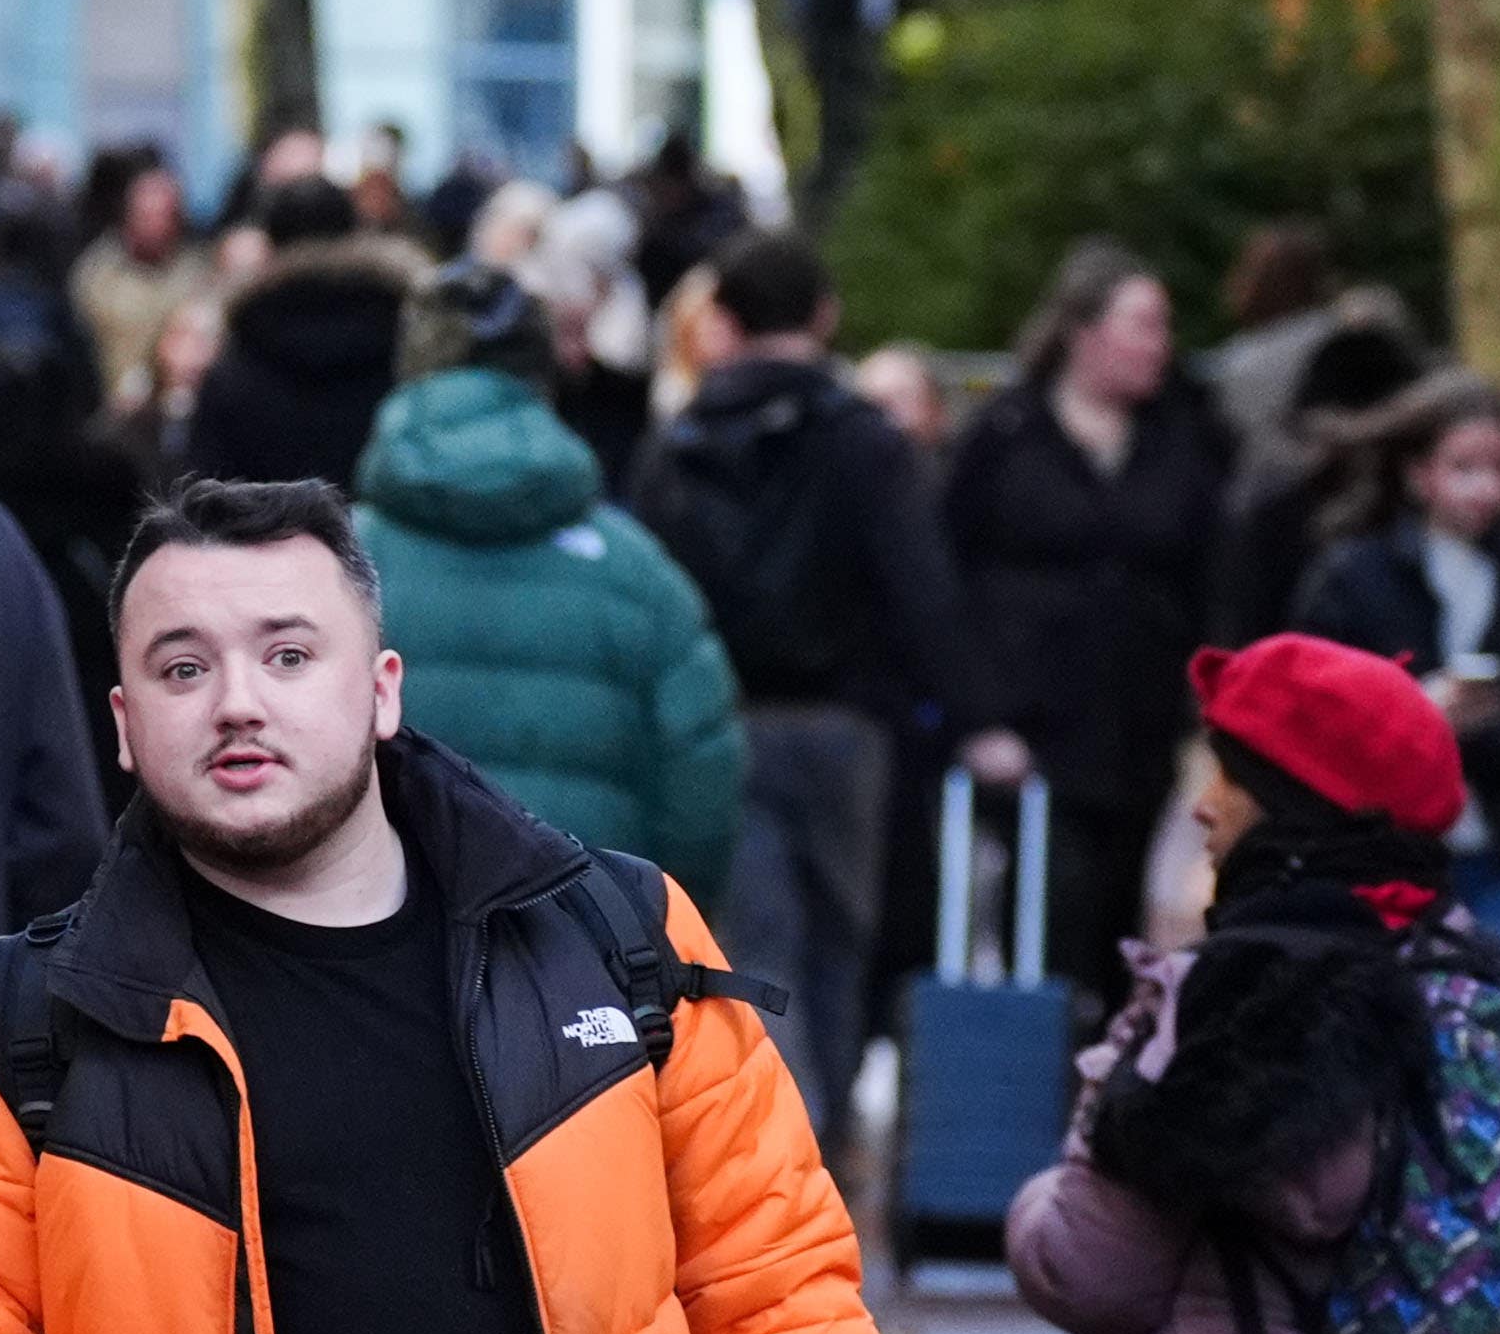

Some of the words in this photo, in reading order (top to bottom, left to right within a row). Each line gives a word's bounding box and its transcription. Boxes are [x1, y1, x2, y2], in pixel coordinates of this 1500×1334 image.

[577, 1008, 608, 1023] THE
[562, 1019, 612, 1039] NORTH
[580, 1031, 617, 1048] FACE
